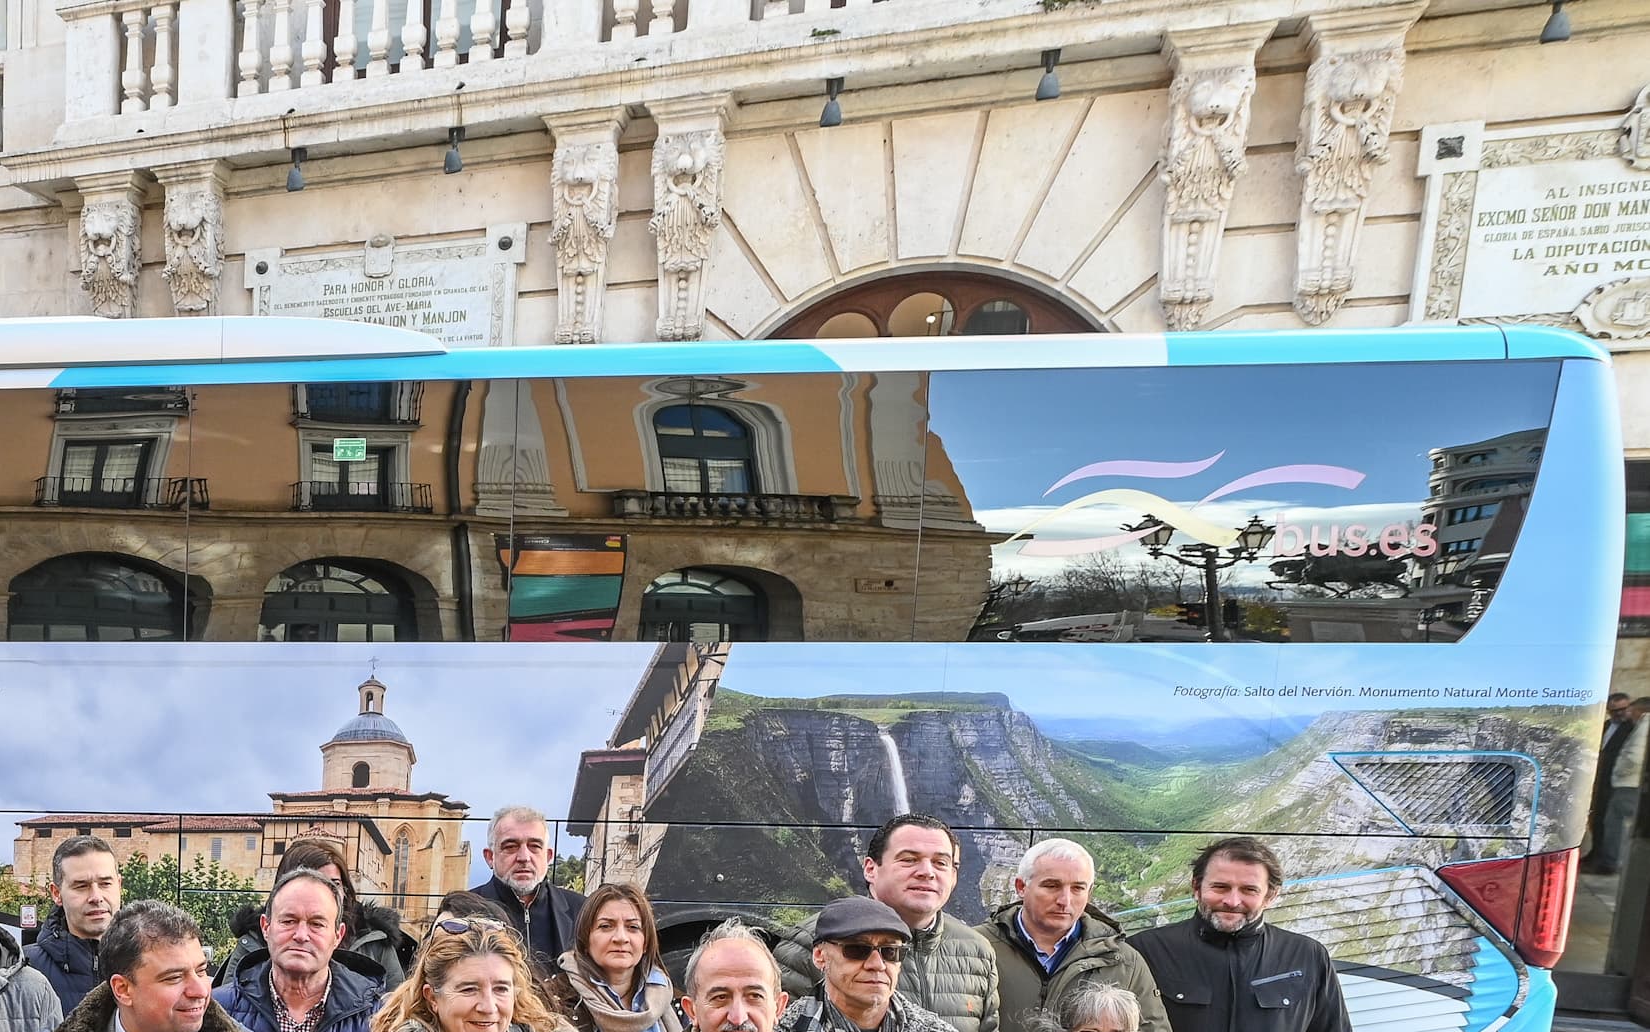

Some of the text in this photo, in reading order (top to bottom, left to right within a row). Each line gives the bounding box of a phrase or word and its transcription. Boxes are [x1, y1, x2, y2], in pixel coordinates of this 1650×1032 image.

[1545, 180, 1650, 200] AL INSIGNE
[1531, 203, 1577, 223] SEÑOR
[1583, 202, 1612, 219] DON
[1484, 231, 1517, 243] GLORIA
[1521, 229, 1533, 240] DE
[1512, 247, 1535, 261] LA
[1543, 260, 1599, 277] AÑO
[323, 284, 347, 296] PARA
[351, 280, 384, 293] HONOR
[389, 279, 395, 290] Y
[323, 300, 432, 318] ESCUELAS DEL AVE-MARIA
[411, 314, 418, 326] Y
[422, 310, 467, 325] MANJON
[1274, 513, 1438, 558] bus.es
[1173, 685, 1593, 701] Fotografía: Salto del Nervión. Monumento Natural Monte Santiago
